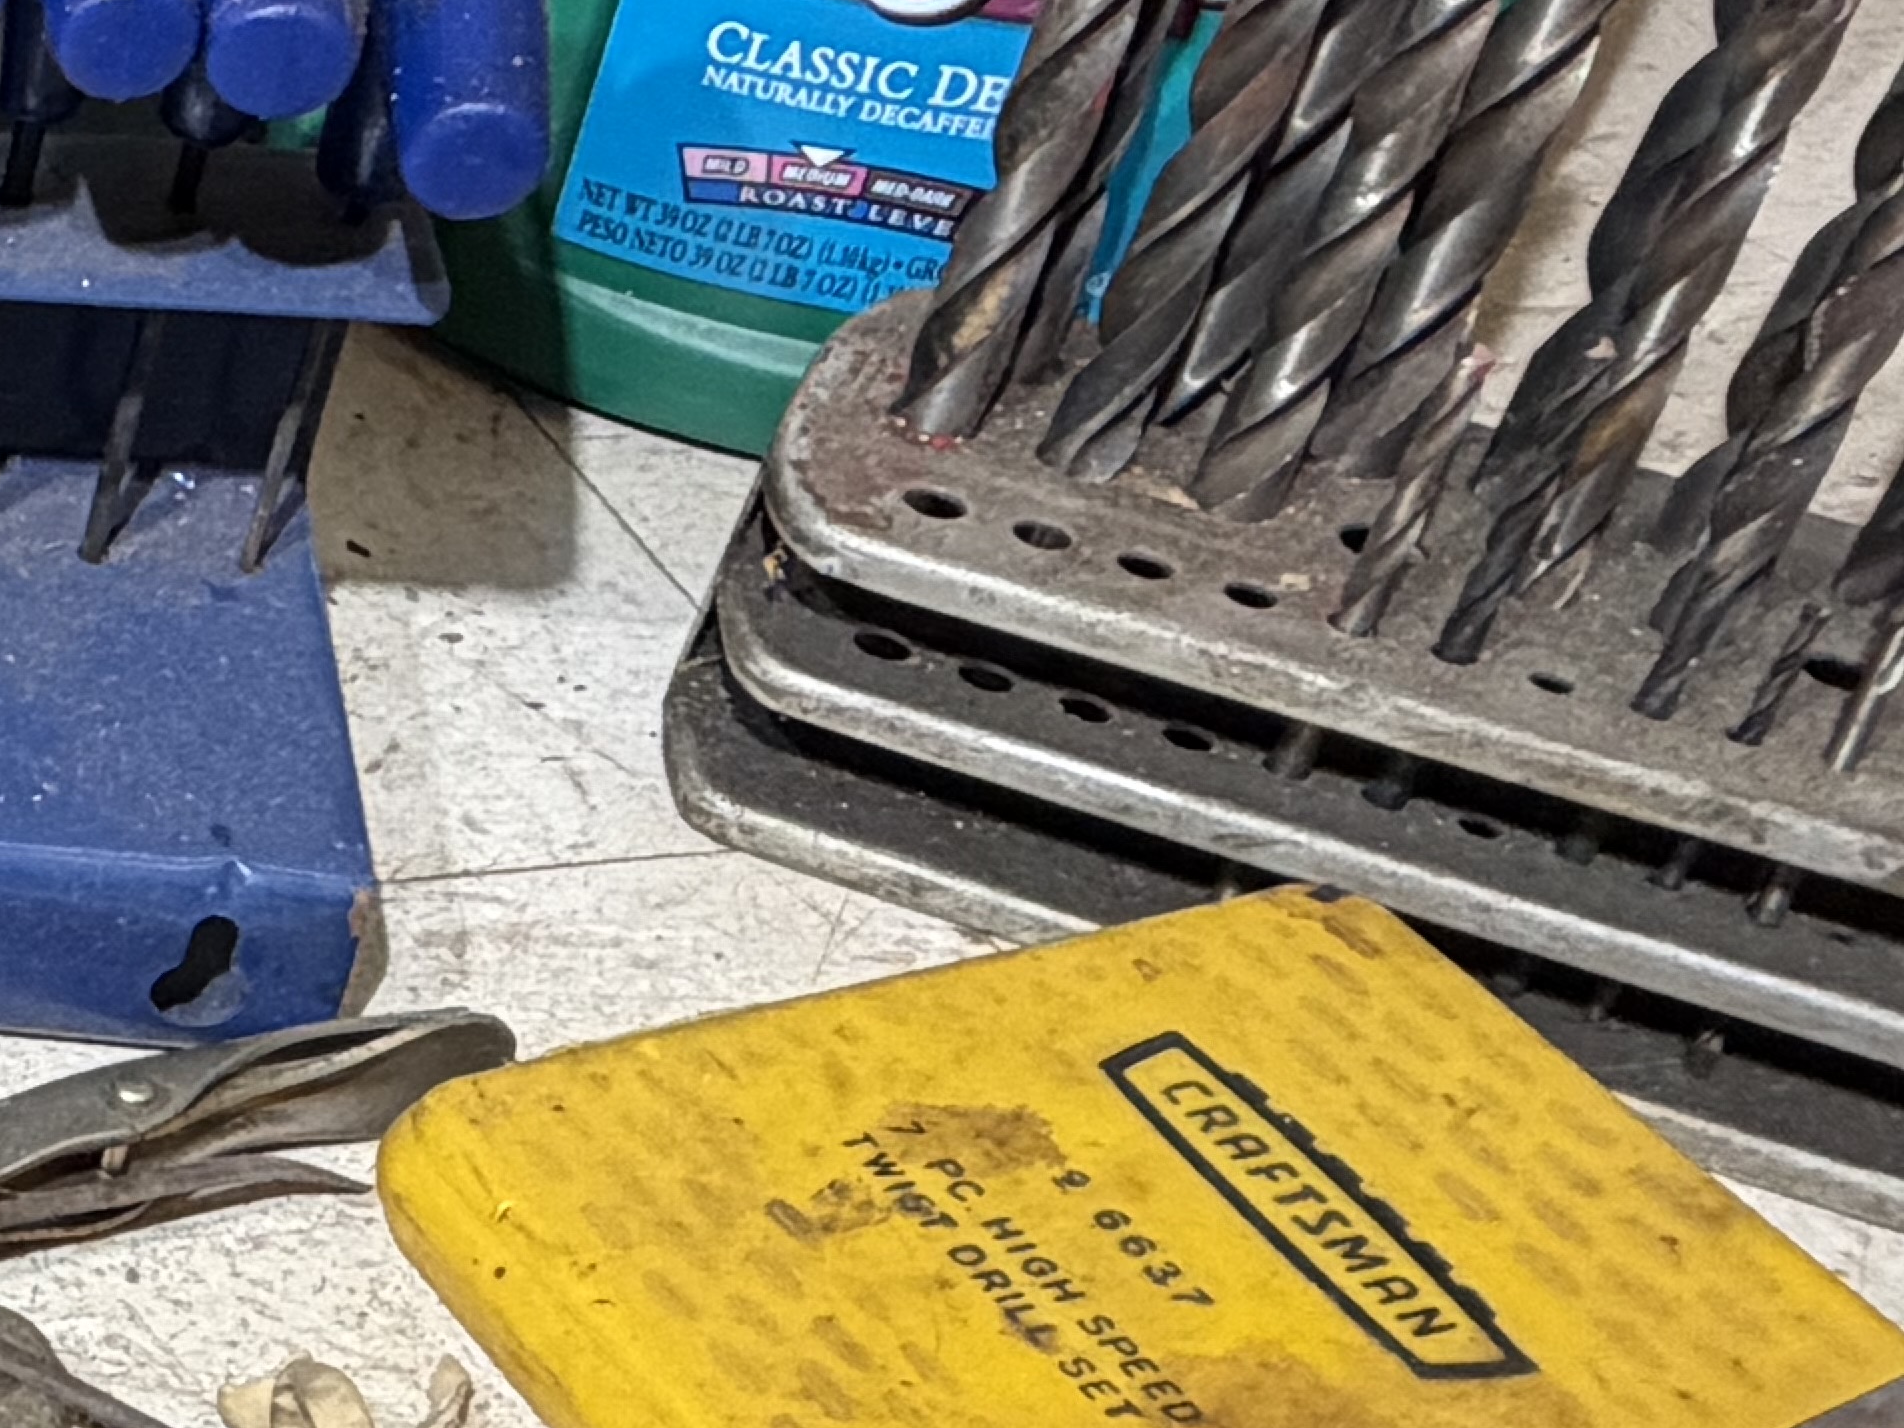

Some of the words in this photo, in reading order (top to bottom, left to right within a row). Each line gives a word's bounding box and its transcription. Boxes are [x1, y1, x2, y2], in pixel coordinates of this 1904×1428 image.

[701, 63, 857, 118] NATURALLY
[858, 98, 998, 141] DECAFFEI
[706, 20, 920, 100] CLASSIC
[578, 176, 621, 211] NET
[623, 191, 658, 223] WT
[654, 201, 681, 229] 39
[680, 209, 714, 238] OZ
[733, 220, 763, 249] LB
[764, 227, 777, 251] 7
[774, 231, 814, 260] OZ)
[704, 156, 747, 175] MILD
[782, 164, 854, 187] MEDIUM
[871, 178, 957, 208] MED-DARK
[738, 185, 851, 217] ROAST
[868, 203, 956, 237] LEVE
[576, 208, 628, 245] PESO
[628, 226, 688, 263] NETO
[687, 243, 714, 269] 39
[715, 250, 748, 277] OZ
[767, 260, 799, 289] LB
[800, 269, 818, 293] 7
[816, 270, 859, 303] OZ)
[1160, 1078, 1458, 1339] CRAFTSMAN
[842, 1132, 960, 1230] TWIST
[946, 1243, 1058, 1347] DRILL
[1058, 1355, 1146, 1419] SET
[884, 1120, 927, 1136] 7
[980, 1217, 1087, 1303] HIGH
[1076, 1313, 1203, 1425] SPEED
[1092, 1208, 1216, 1307] 6637
